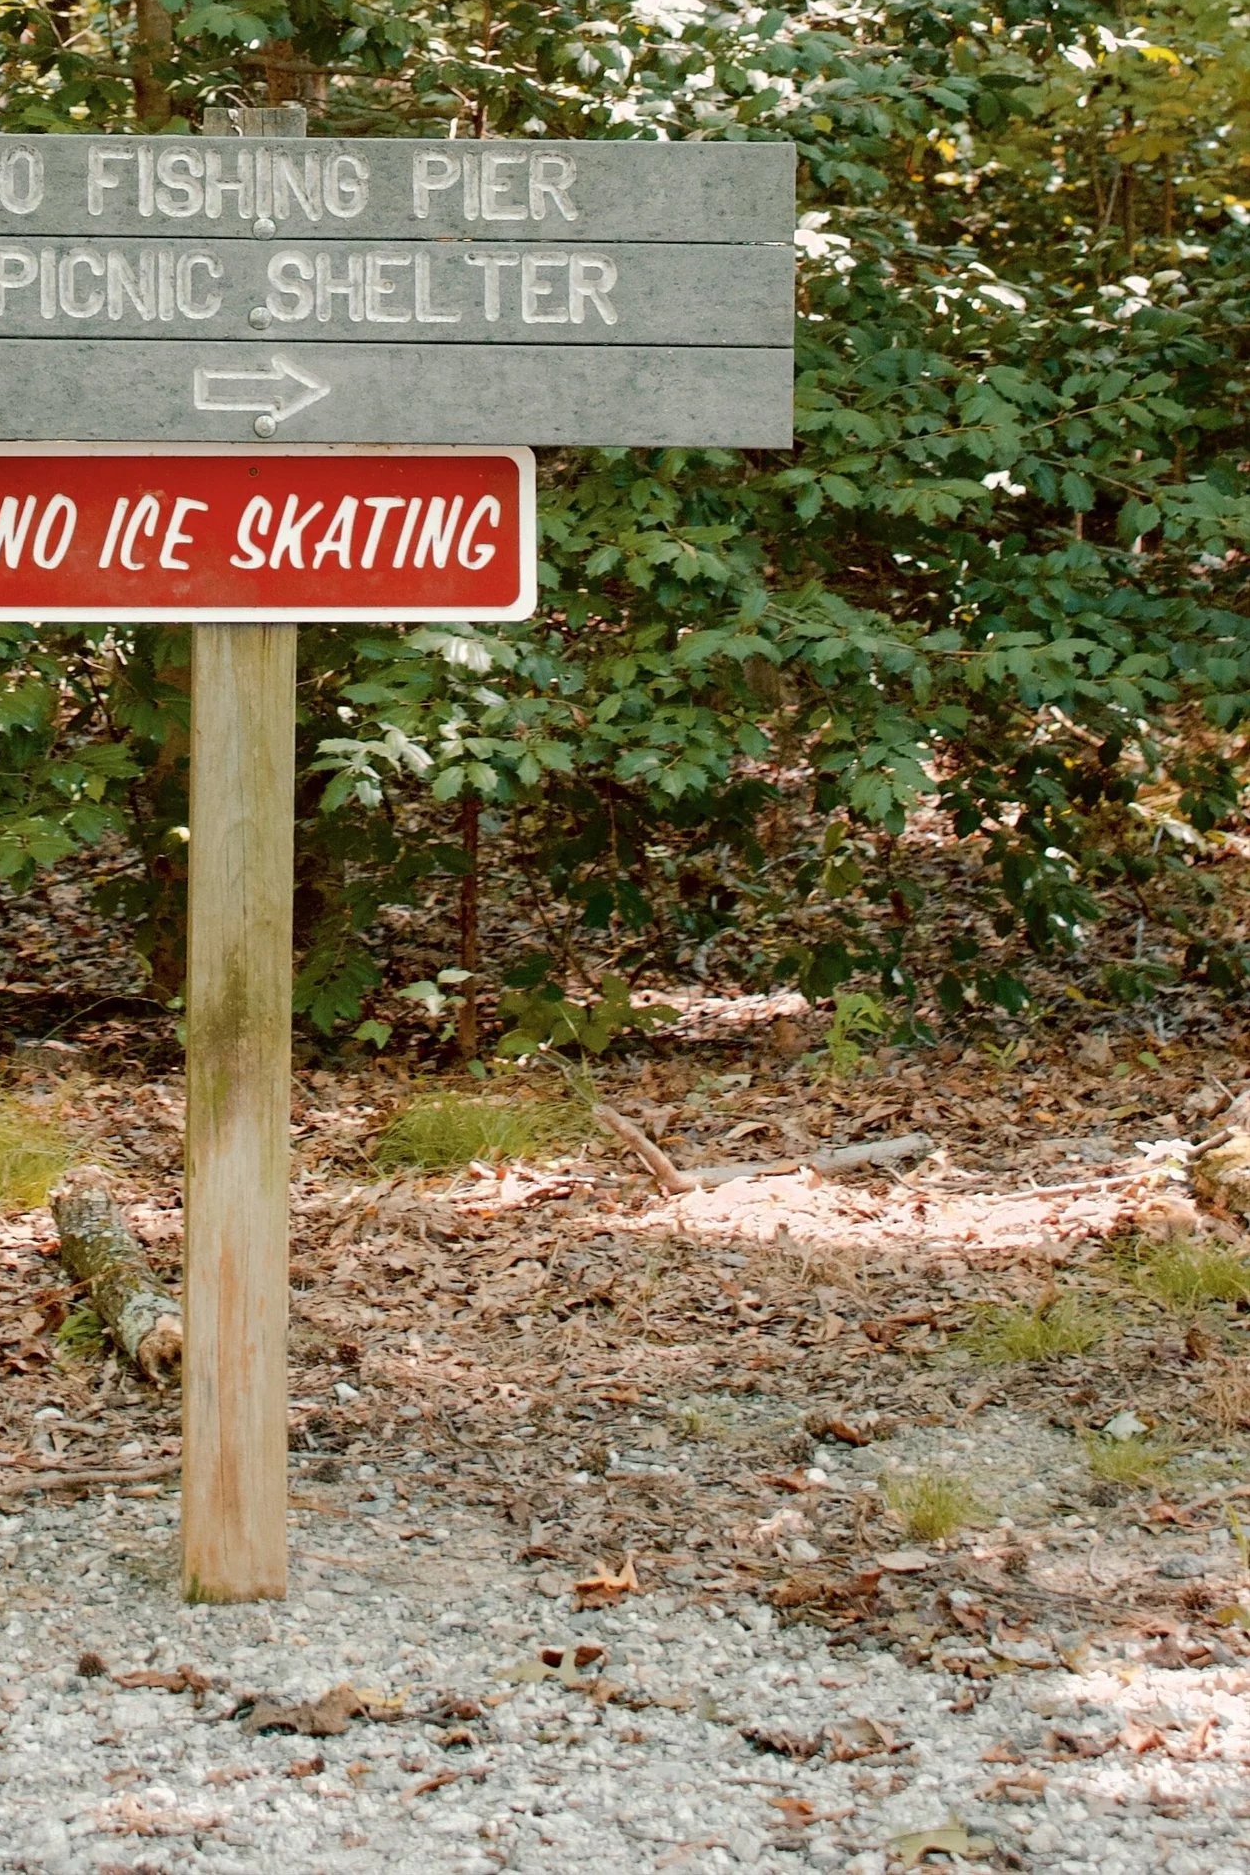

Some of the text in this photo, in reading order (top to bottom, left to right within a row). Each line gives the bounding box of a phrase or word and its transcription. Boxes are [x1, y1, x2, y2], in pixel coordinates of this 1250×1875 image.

[86, 145, 370, 221] FISHING
[412, 149, 579, 222] PIER
[265, 249, 620, 325] SHELTER
[98, 495, 209, 571] ICE
[229, 493, 502, 571] SKATING
